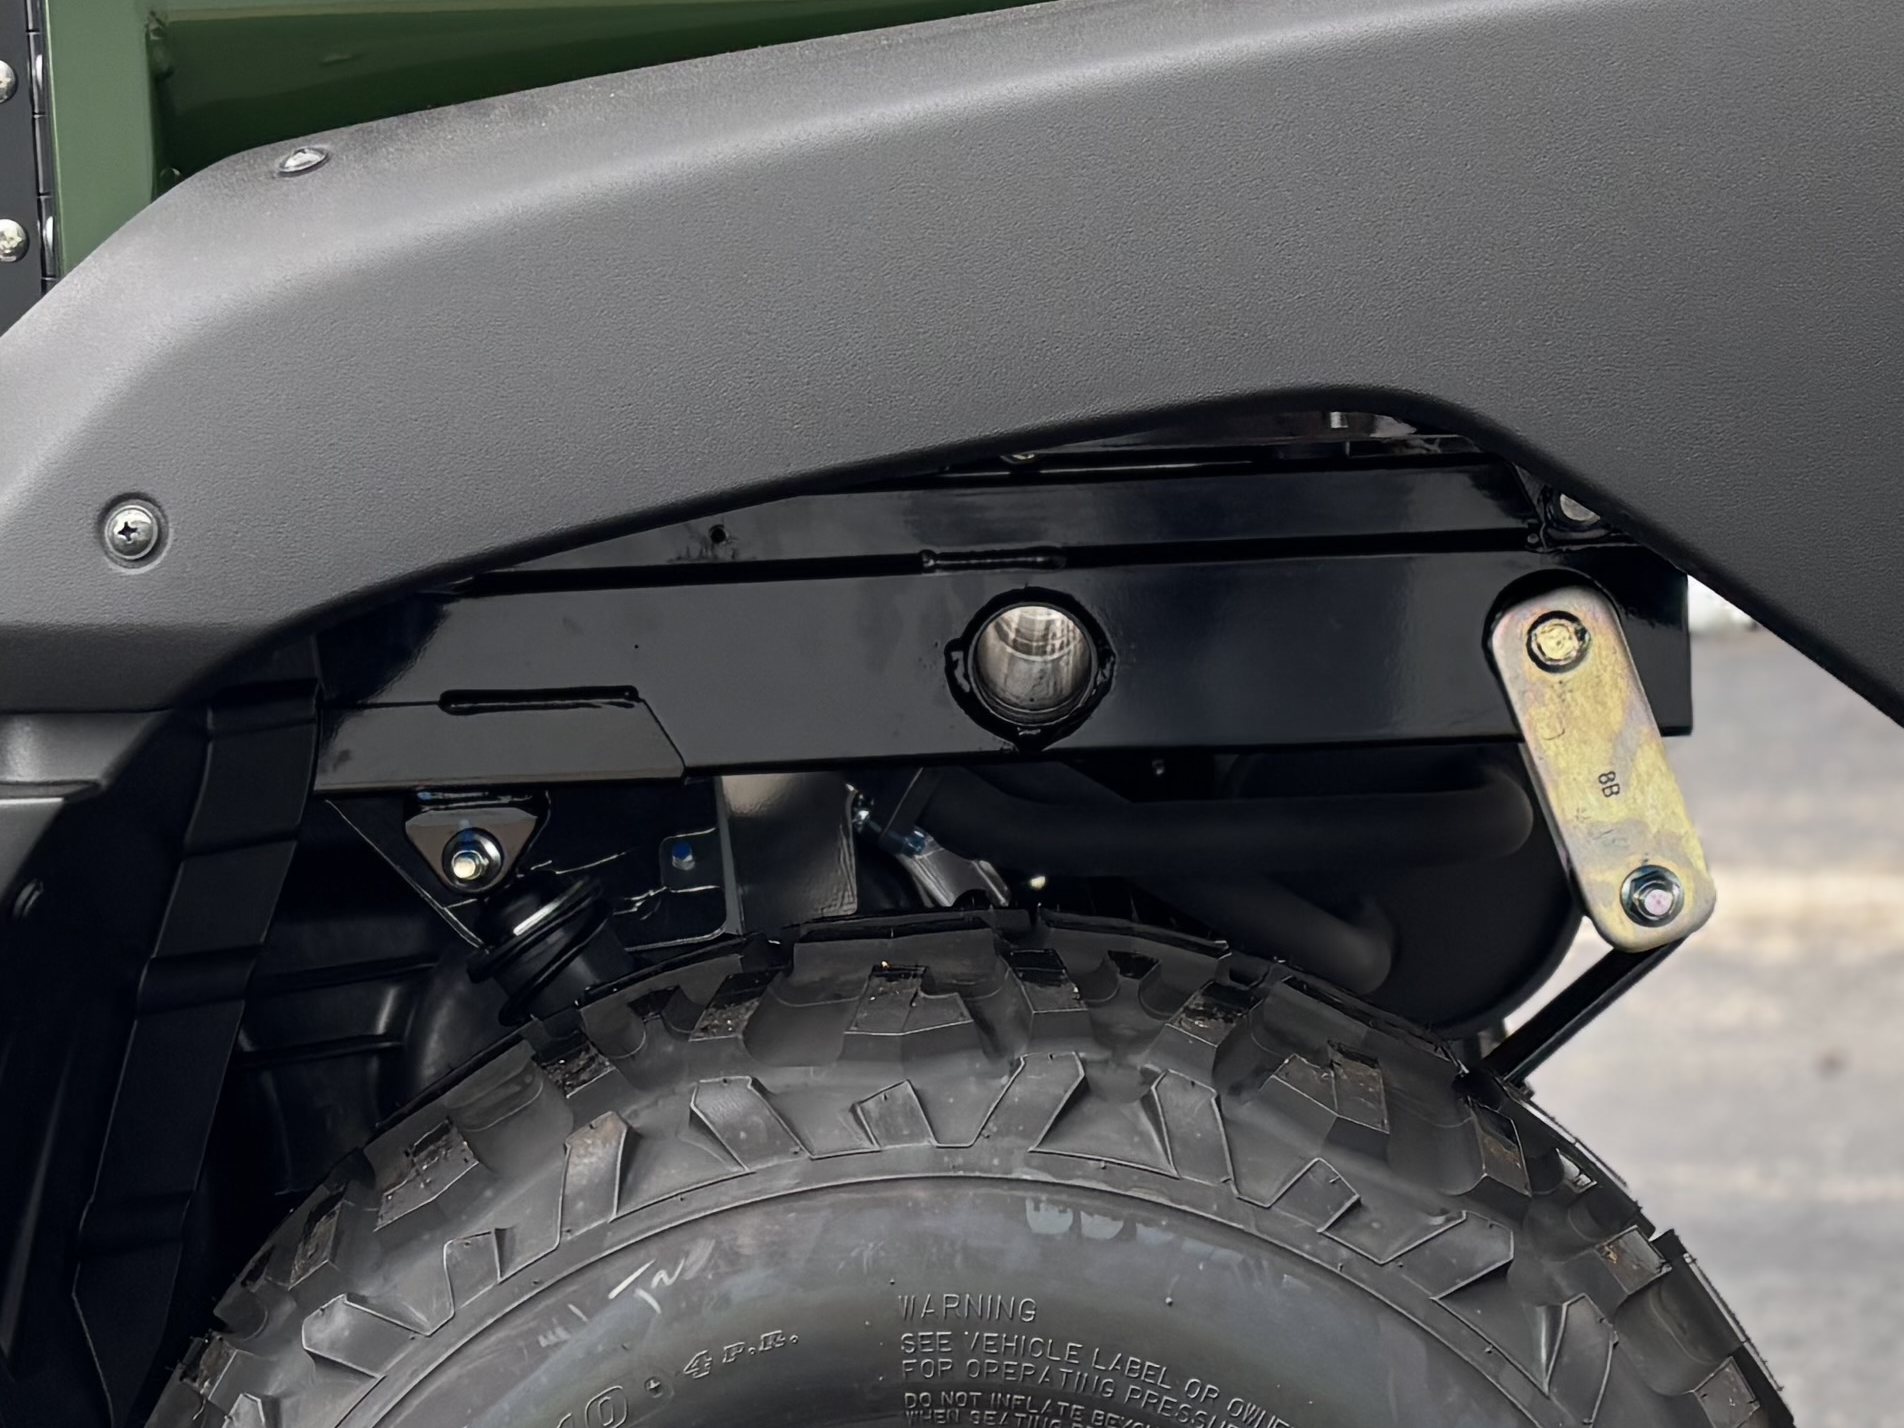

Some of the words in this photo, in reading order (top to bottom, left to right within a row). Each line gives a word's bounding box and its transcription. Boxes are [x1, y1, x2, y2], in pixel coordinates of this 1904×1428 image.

[1597, 770, 1622, 799] 8B
[898, 1293, 1037, 1322] WARNING
[900, 1331, 954, 1355] SEE
[963, 1331, 1084, 1364] VEHICLE
[1091, 1347, 1172, 1390] LABEL
[904, 1391, 933, 1410] DO
[940, 1390, 983, 1408] NOT
[990, 1392, 1086, 1421] INFLATE
